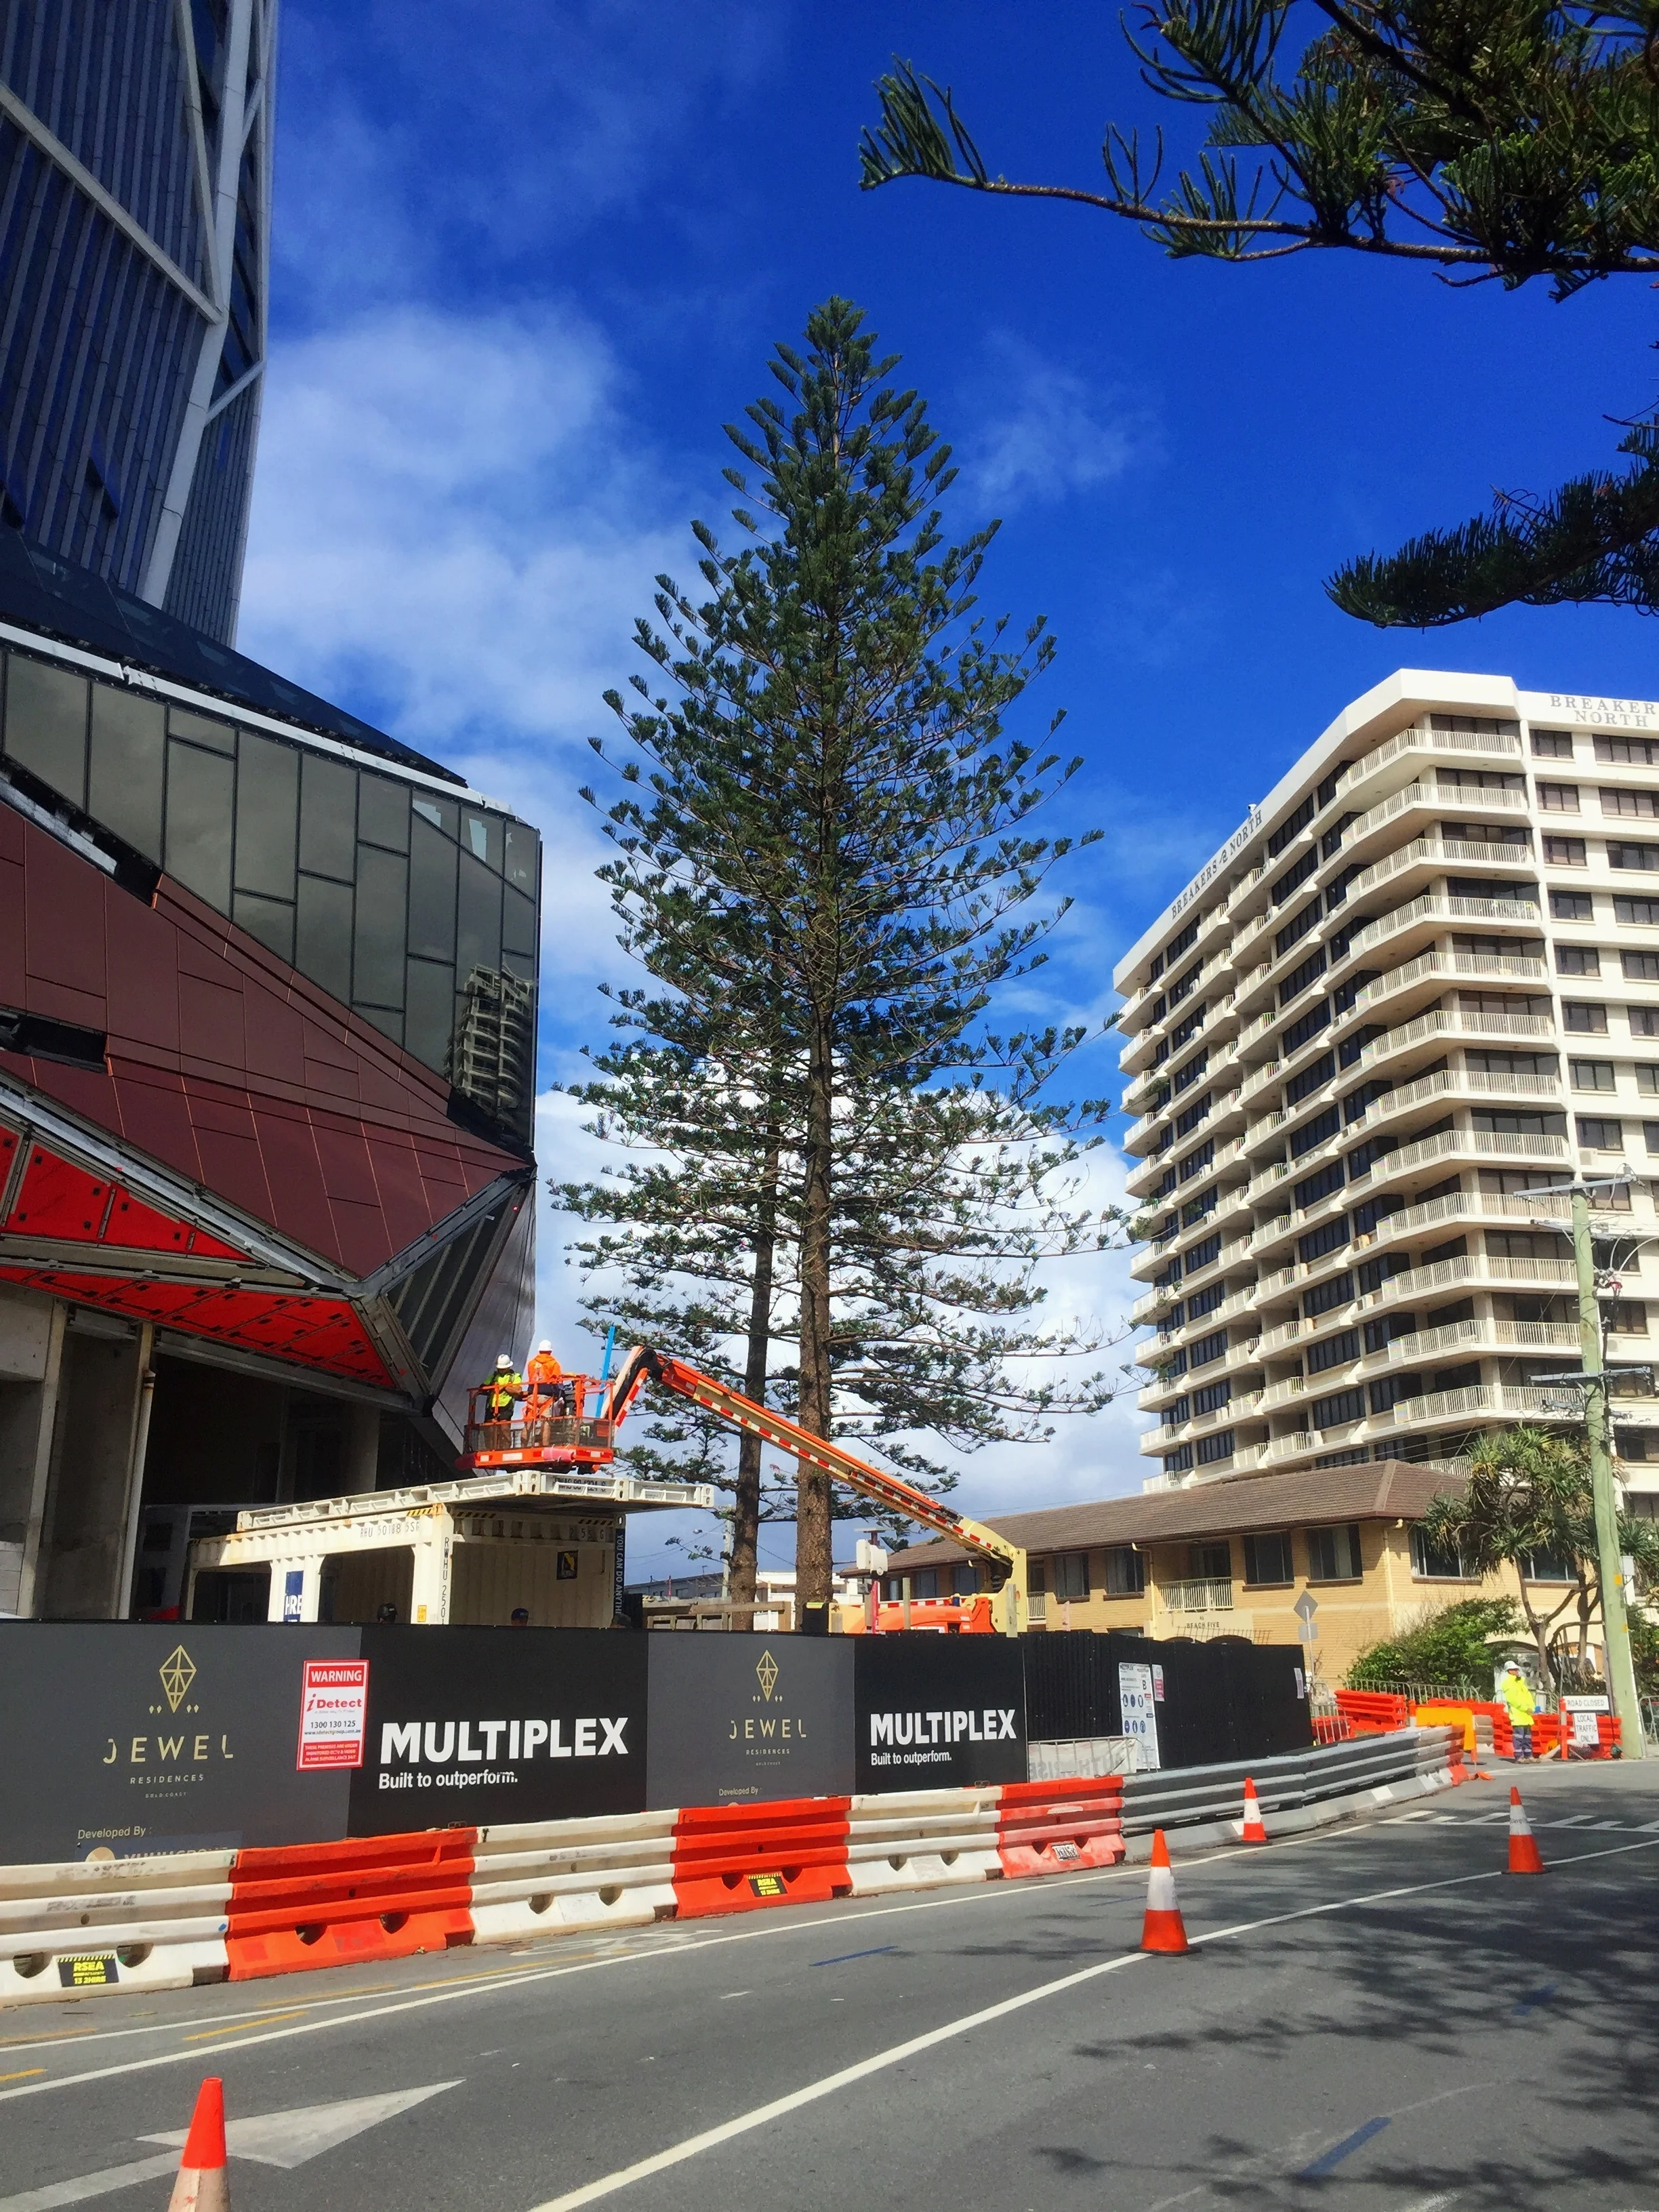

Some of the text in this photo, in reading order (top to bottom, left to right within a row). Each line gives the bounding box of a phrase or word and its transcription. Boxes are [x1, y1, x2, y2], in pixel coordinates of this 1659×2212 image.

[1574, 710, 1649, 727] NORTH
[1171, 809, 1263, 920] BREAKERS NORTH
[615, 1571, 623, 1583] DO
[311, 1670, 362, 1683] WARNING
[729, 1719, 806, 1740] JEWEL
[870, 1709, 1017, 1746] MULTIPLEX
[1576, 1724, 1597, 1732] TRAFFIC
[380, 1717, 629, 1764] MULTIPLEX
[103, 1734, 234, 1764] JEWEL
[871, 1750, 952, 1766] Built to outperform.
[130, 1774, 204, 1785] RESIDENCES
[379, 1769, 518, 1790] Built to outperform.
[719, 1786, 758, 1797] Developed By
[78, 1828, 130, 1839] Developed
[134, 1826, 146, 1837] By
[73, 1961, 105, 1972] RSEA
